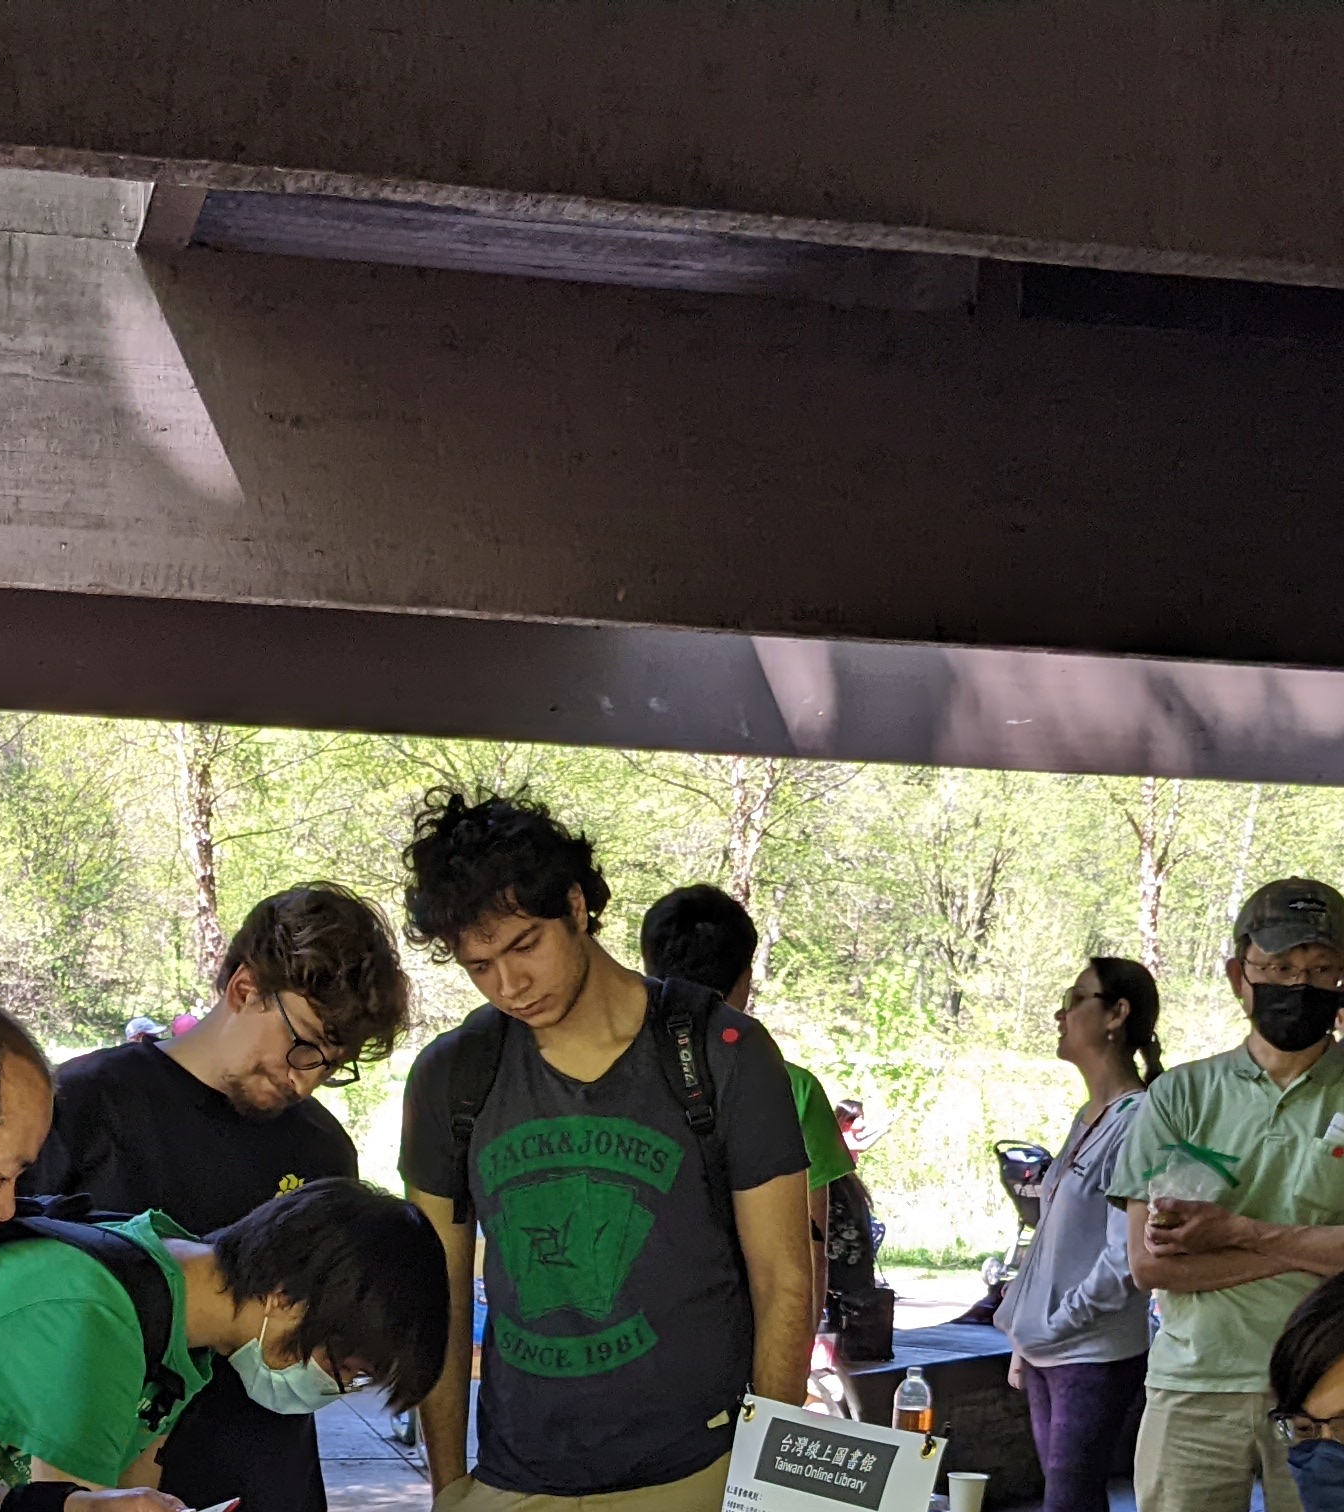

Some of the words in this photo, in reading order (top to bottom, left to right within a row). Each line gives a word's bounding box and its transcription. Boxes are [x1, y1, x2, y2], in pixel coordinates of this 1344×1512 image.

[488, 1129, 669, 1177] JACK&JONES
[501, 1330, 572, 1368] SINCE
[585, 1326, 645, 1365] 1981
[779, 1433, 877, 1473] 台灣線上圖書館
[774, 1456, 803, 1475] Taiwan
[804, 1464, 833, 1483] Online
[834, 1471, 867, 1494] Library
